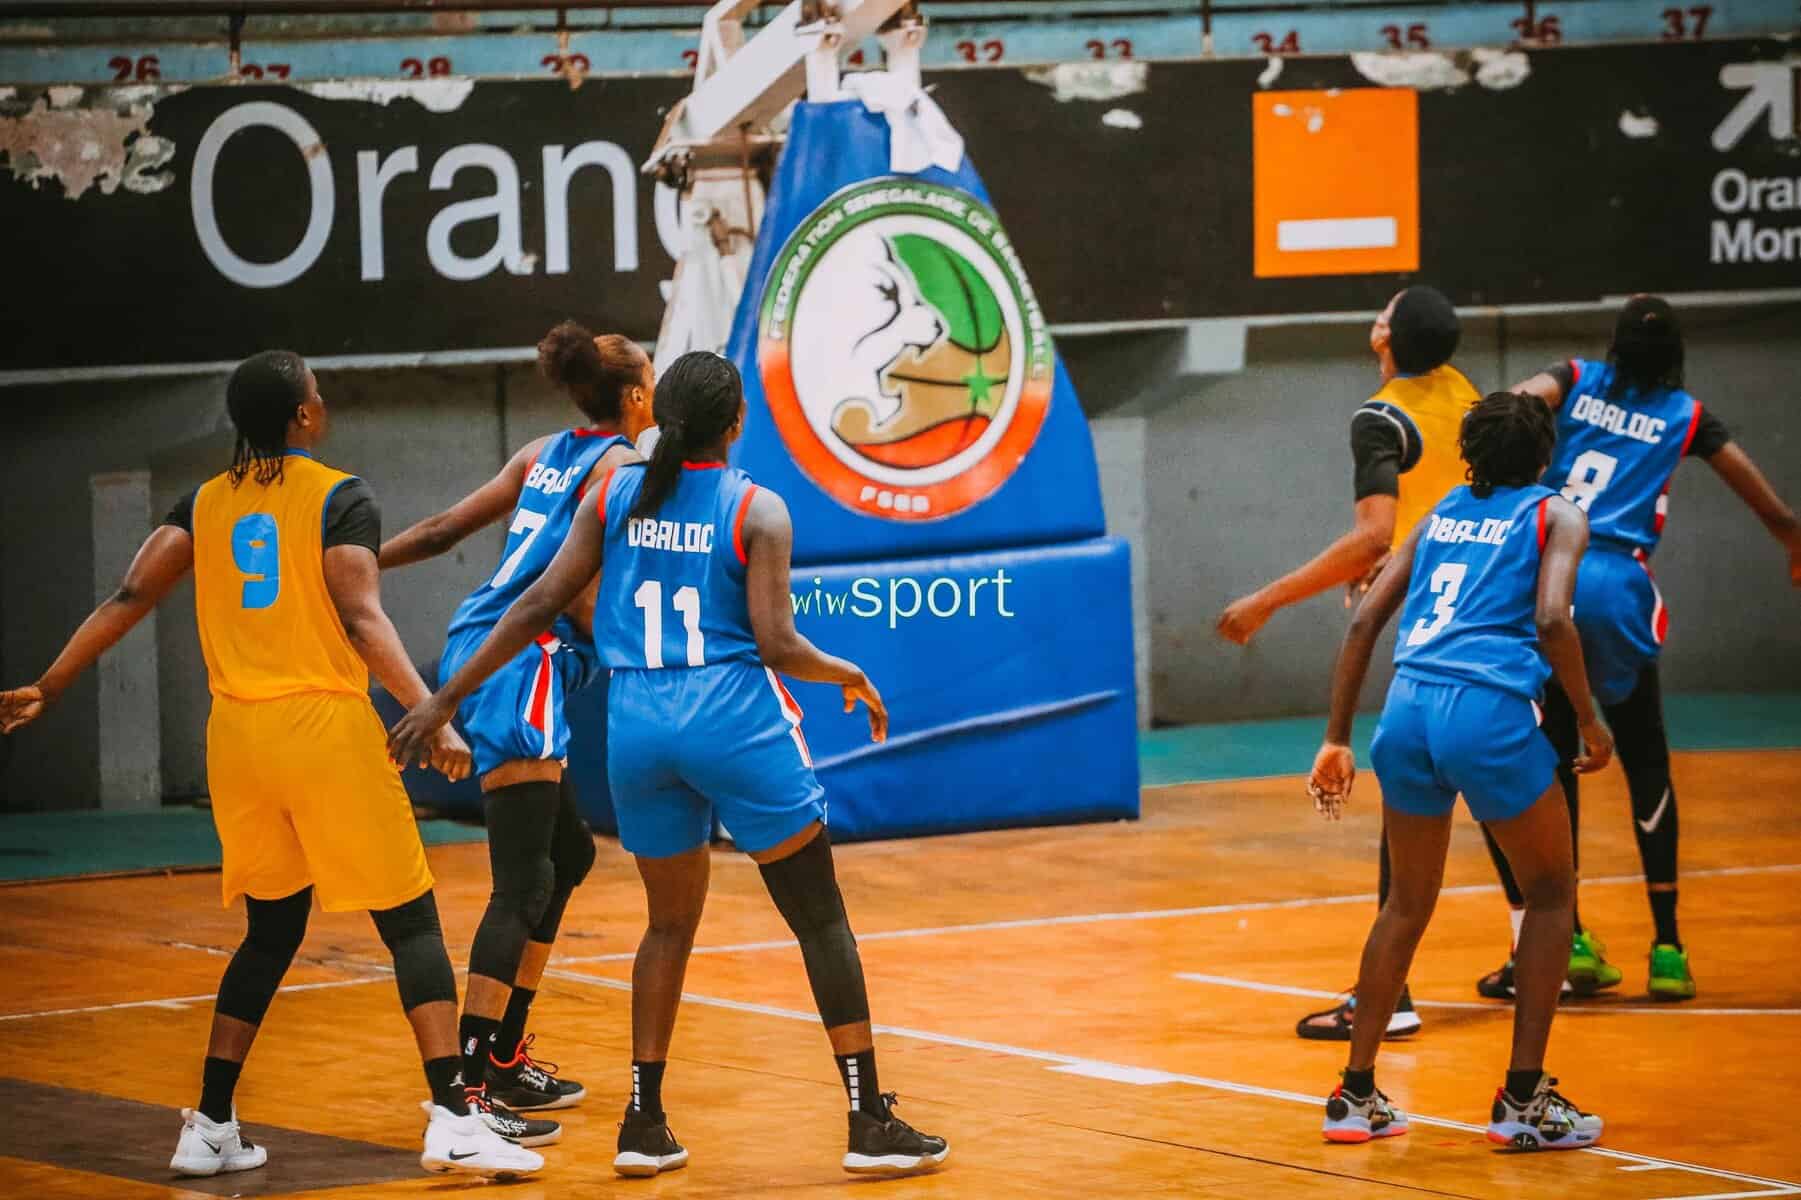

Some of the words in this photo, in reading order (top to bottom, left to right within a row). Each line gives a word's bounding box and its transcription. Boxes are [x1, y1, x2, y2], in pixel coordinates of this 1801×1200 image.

[1252, 27, 1302, 55] 34
[1380, 22, 1431, 50] 35
[1659, 5, 1713, 40] 37
[107, 54, 161, 82] 26
[400, 54, 452, 80] 28
[1711, 167, 1801, 213] Ora
[1559, 449, 1618, 512] 8
[231, 512, 280, 609] 9
[491, 508, 548, 588] 7
[634, 580, 705, 669] 11
[1406, 562, 1468, 647] 3
